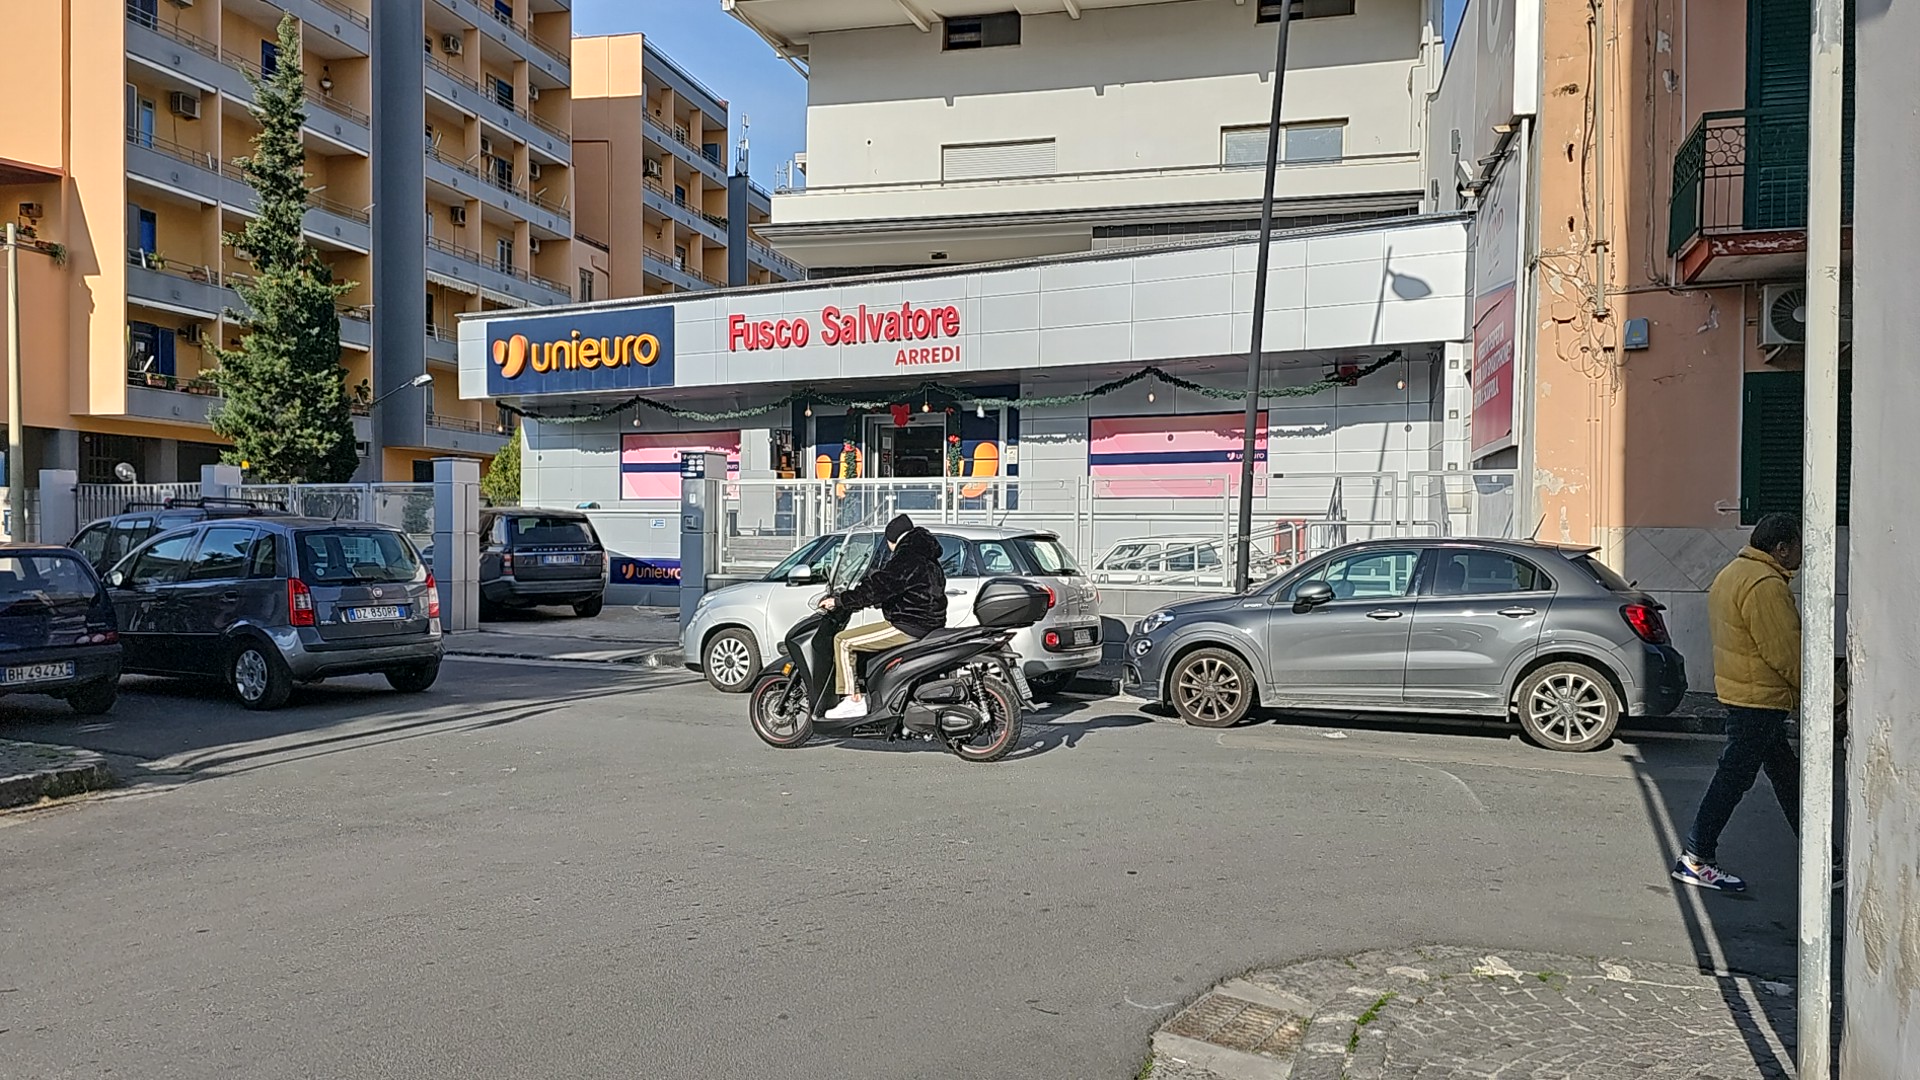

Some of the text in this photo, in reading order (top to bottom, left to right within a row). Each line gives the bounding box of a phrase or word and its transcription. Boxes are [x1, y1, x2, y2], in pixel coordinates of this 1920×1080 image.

[728, 301, 961, 352] Fusco Salvatore
[531, 329, 660, 373] unieuro
[895, 345, 961, 366] ARREDI
[355, 608, 367, 619] DZ
[8, 663, 65, 681] BH 494ZX
